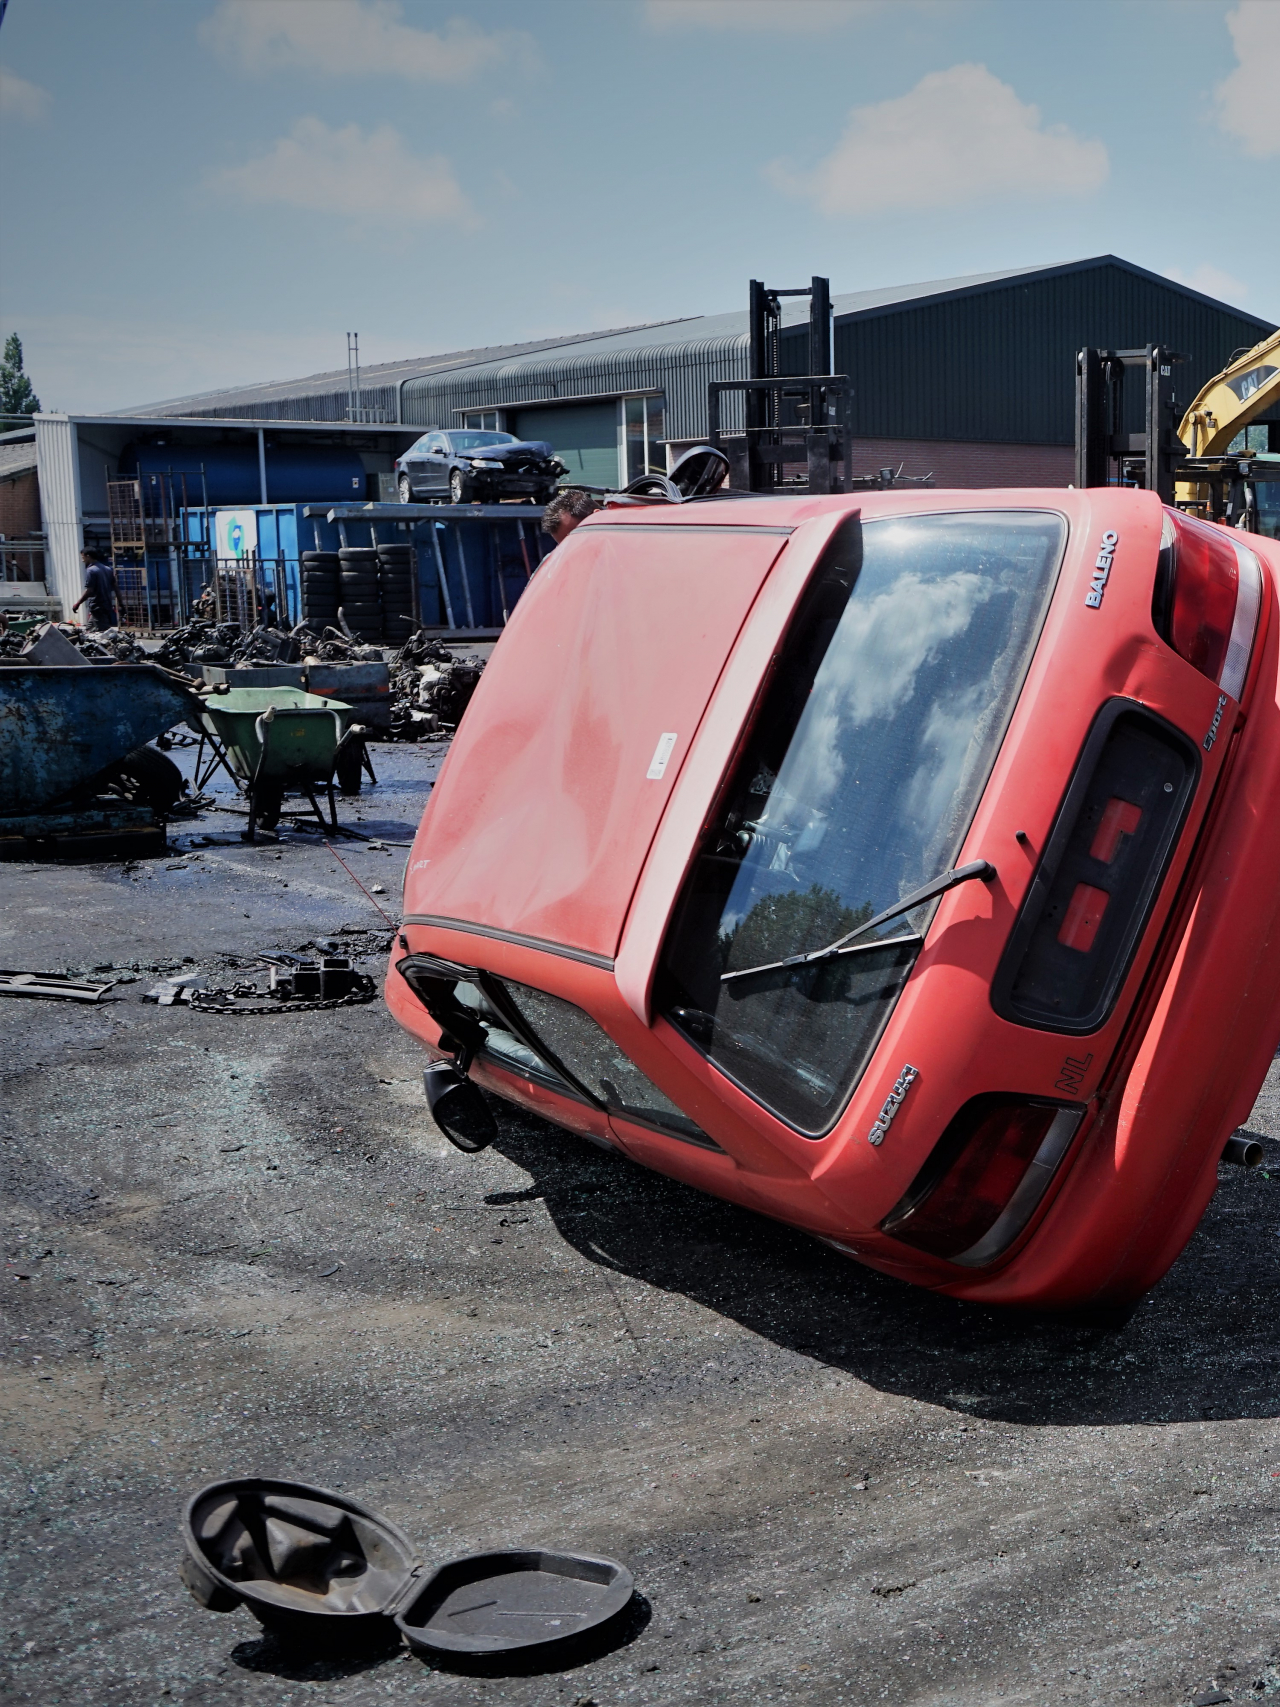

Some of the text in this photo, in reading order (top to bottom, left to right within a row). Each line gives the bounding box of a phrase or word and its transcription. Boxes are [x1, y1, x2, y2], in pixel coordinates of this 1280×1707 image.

[1160, 364, 1171, 376] CAT
[1241, 370, 1261, 400] CAT
[1084, 529, 1119, 610] BALENO
[1202, 694, 1227, 752] Sport
[1054, 1053, 1094, 1095] NL
[867, 1063, 919, 1146] SUZUKI
